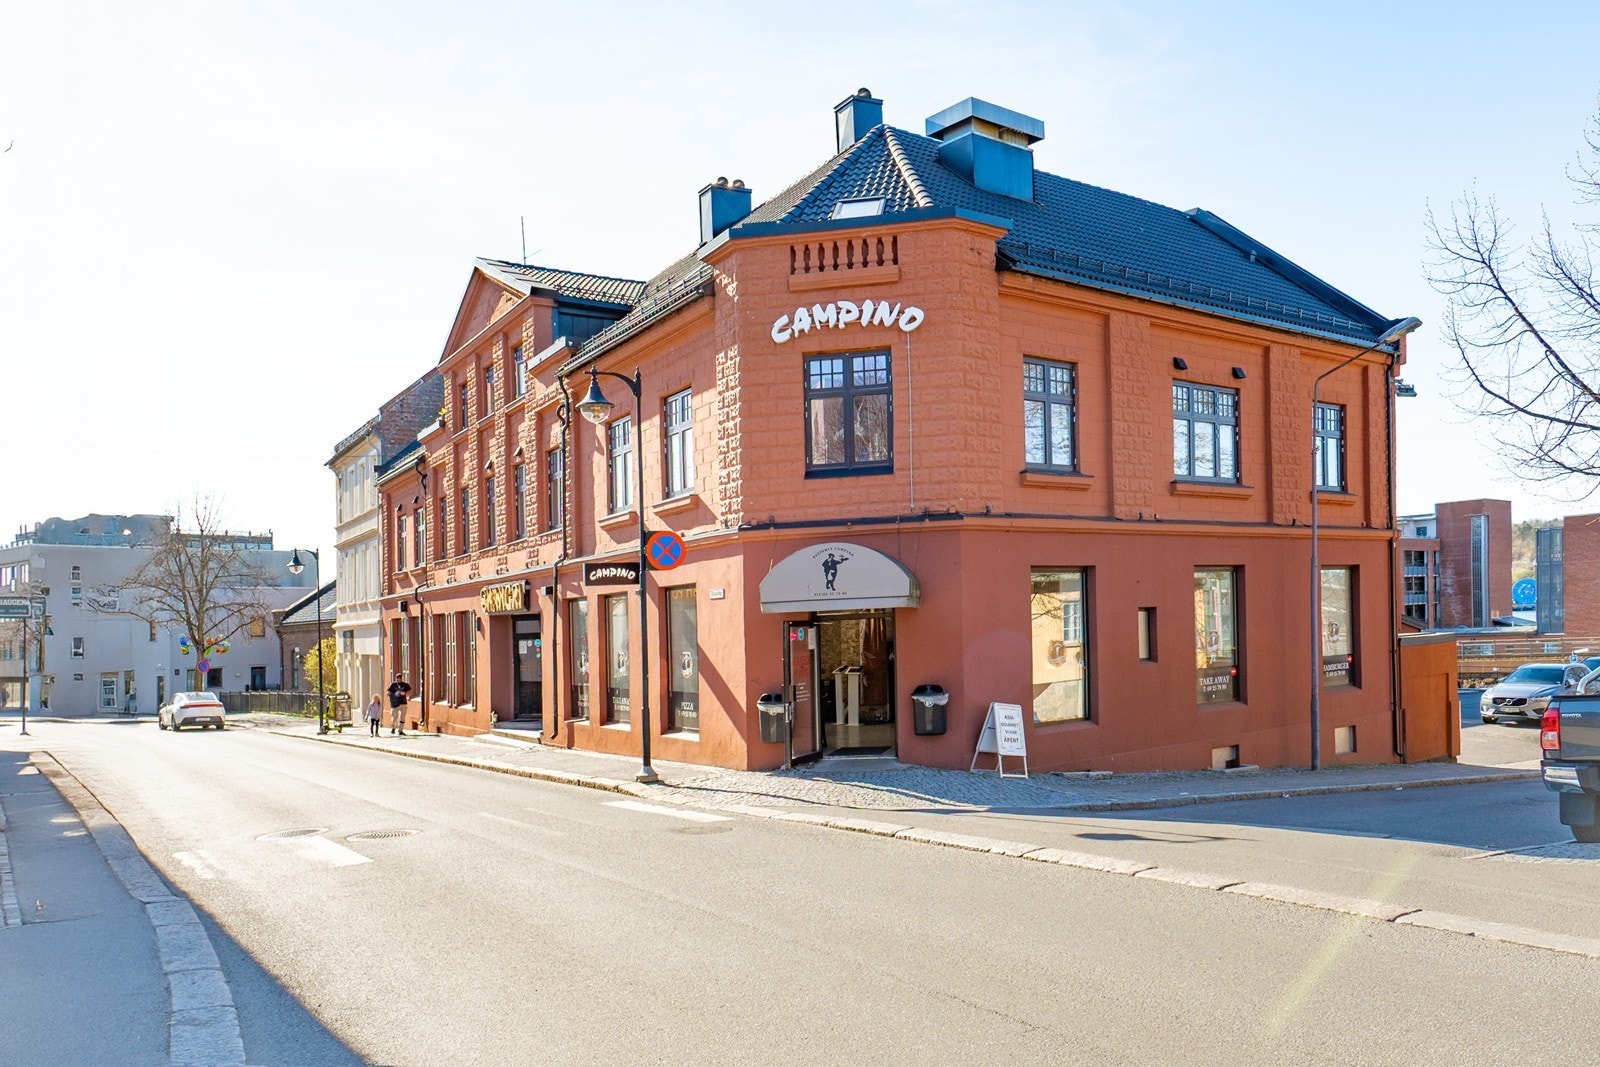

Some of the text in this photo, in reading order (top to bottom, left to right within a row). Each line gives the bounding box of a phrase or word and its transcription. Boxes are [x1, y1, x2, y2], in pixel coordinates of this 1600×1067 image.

[771, 299, 925, 344] CAMPINO
[589, 567, 636, 581] CAMPINO
[1199, 675, 1230, 686] TAKE AWAY
